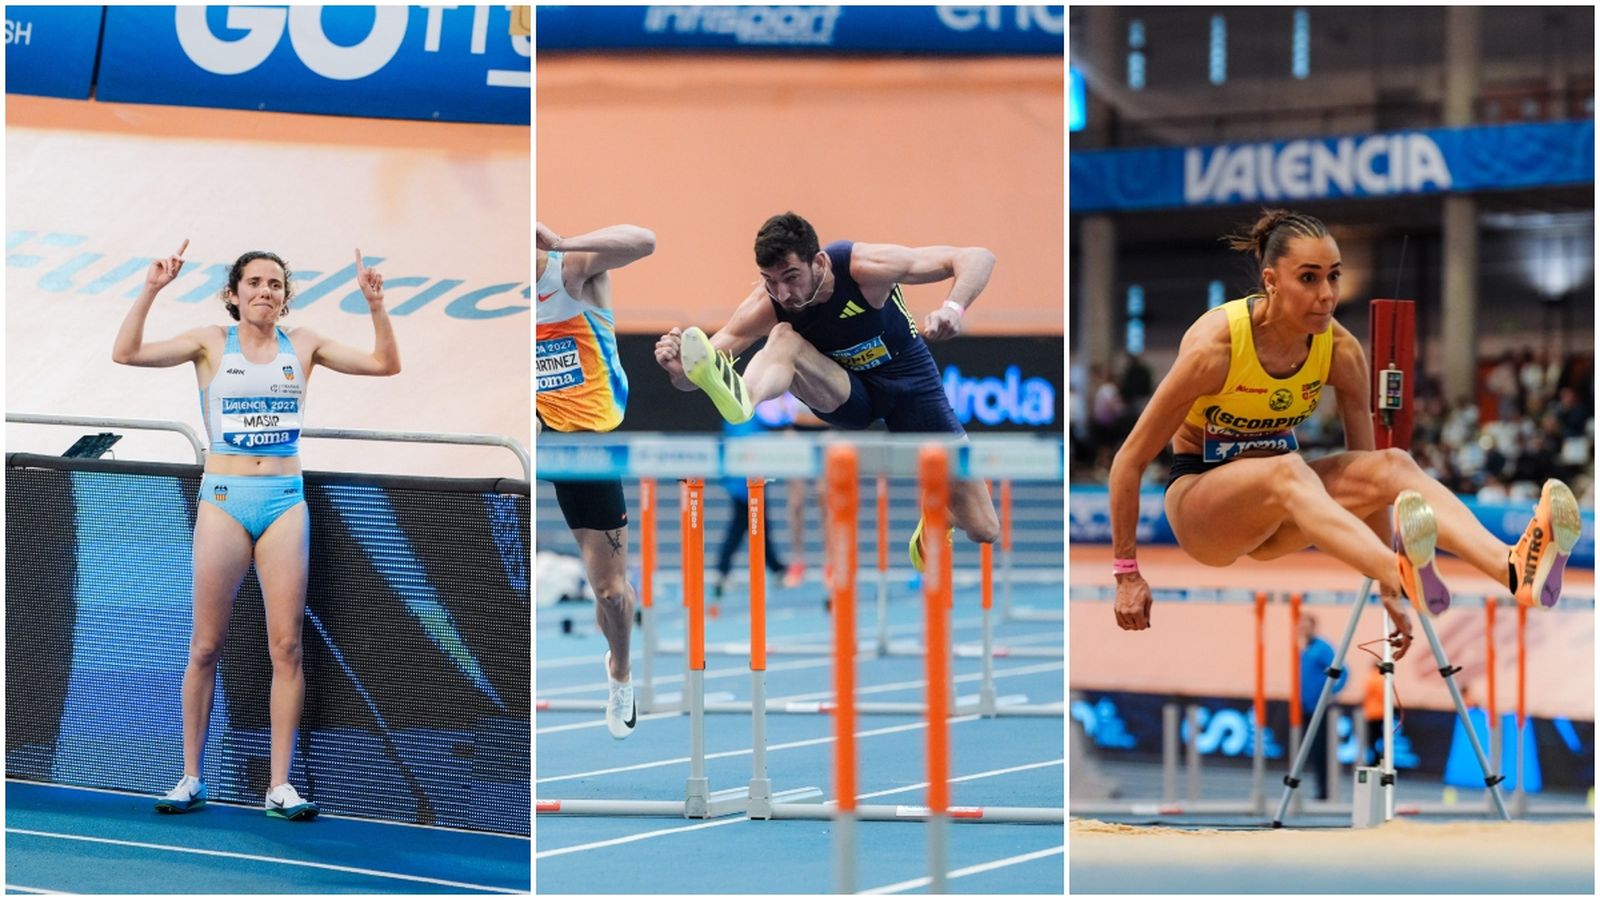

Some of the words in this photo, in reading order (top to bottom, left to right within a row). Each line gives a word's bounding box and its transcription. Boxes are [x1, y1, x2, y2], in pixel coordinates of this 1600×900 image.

[1184, 134, 1452, 203] VALENCIA
[547, 340, 572, 351] 2027
[225, 401, 268, 410] VALENCIA
[271, 401, 296, 411] 2027
[244, 415, 280, 428] MASIP
[1522, 526, 1544, 586] NITRO
